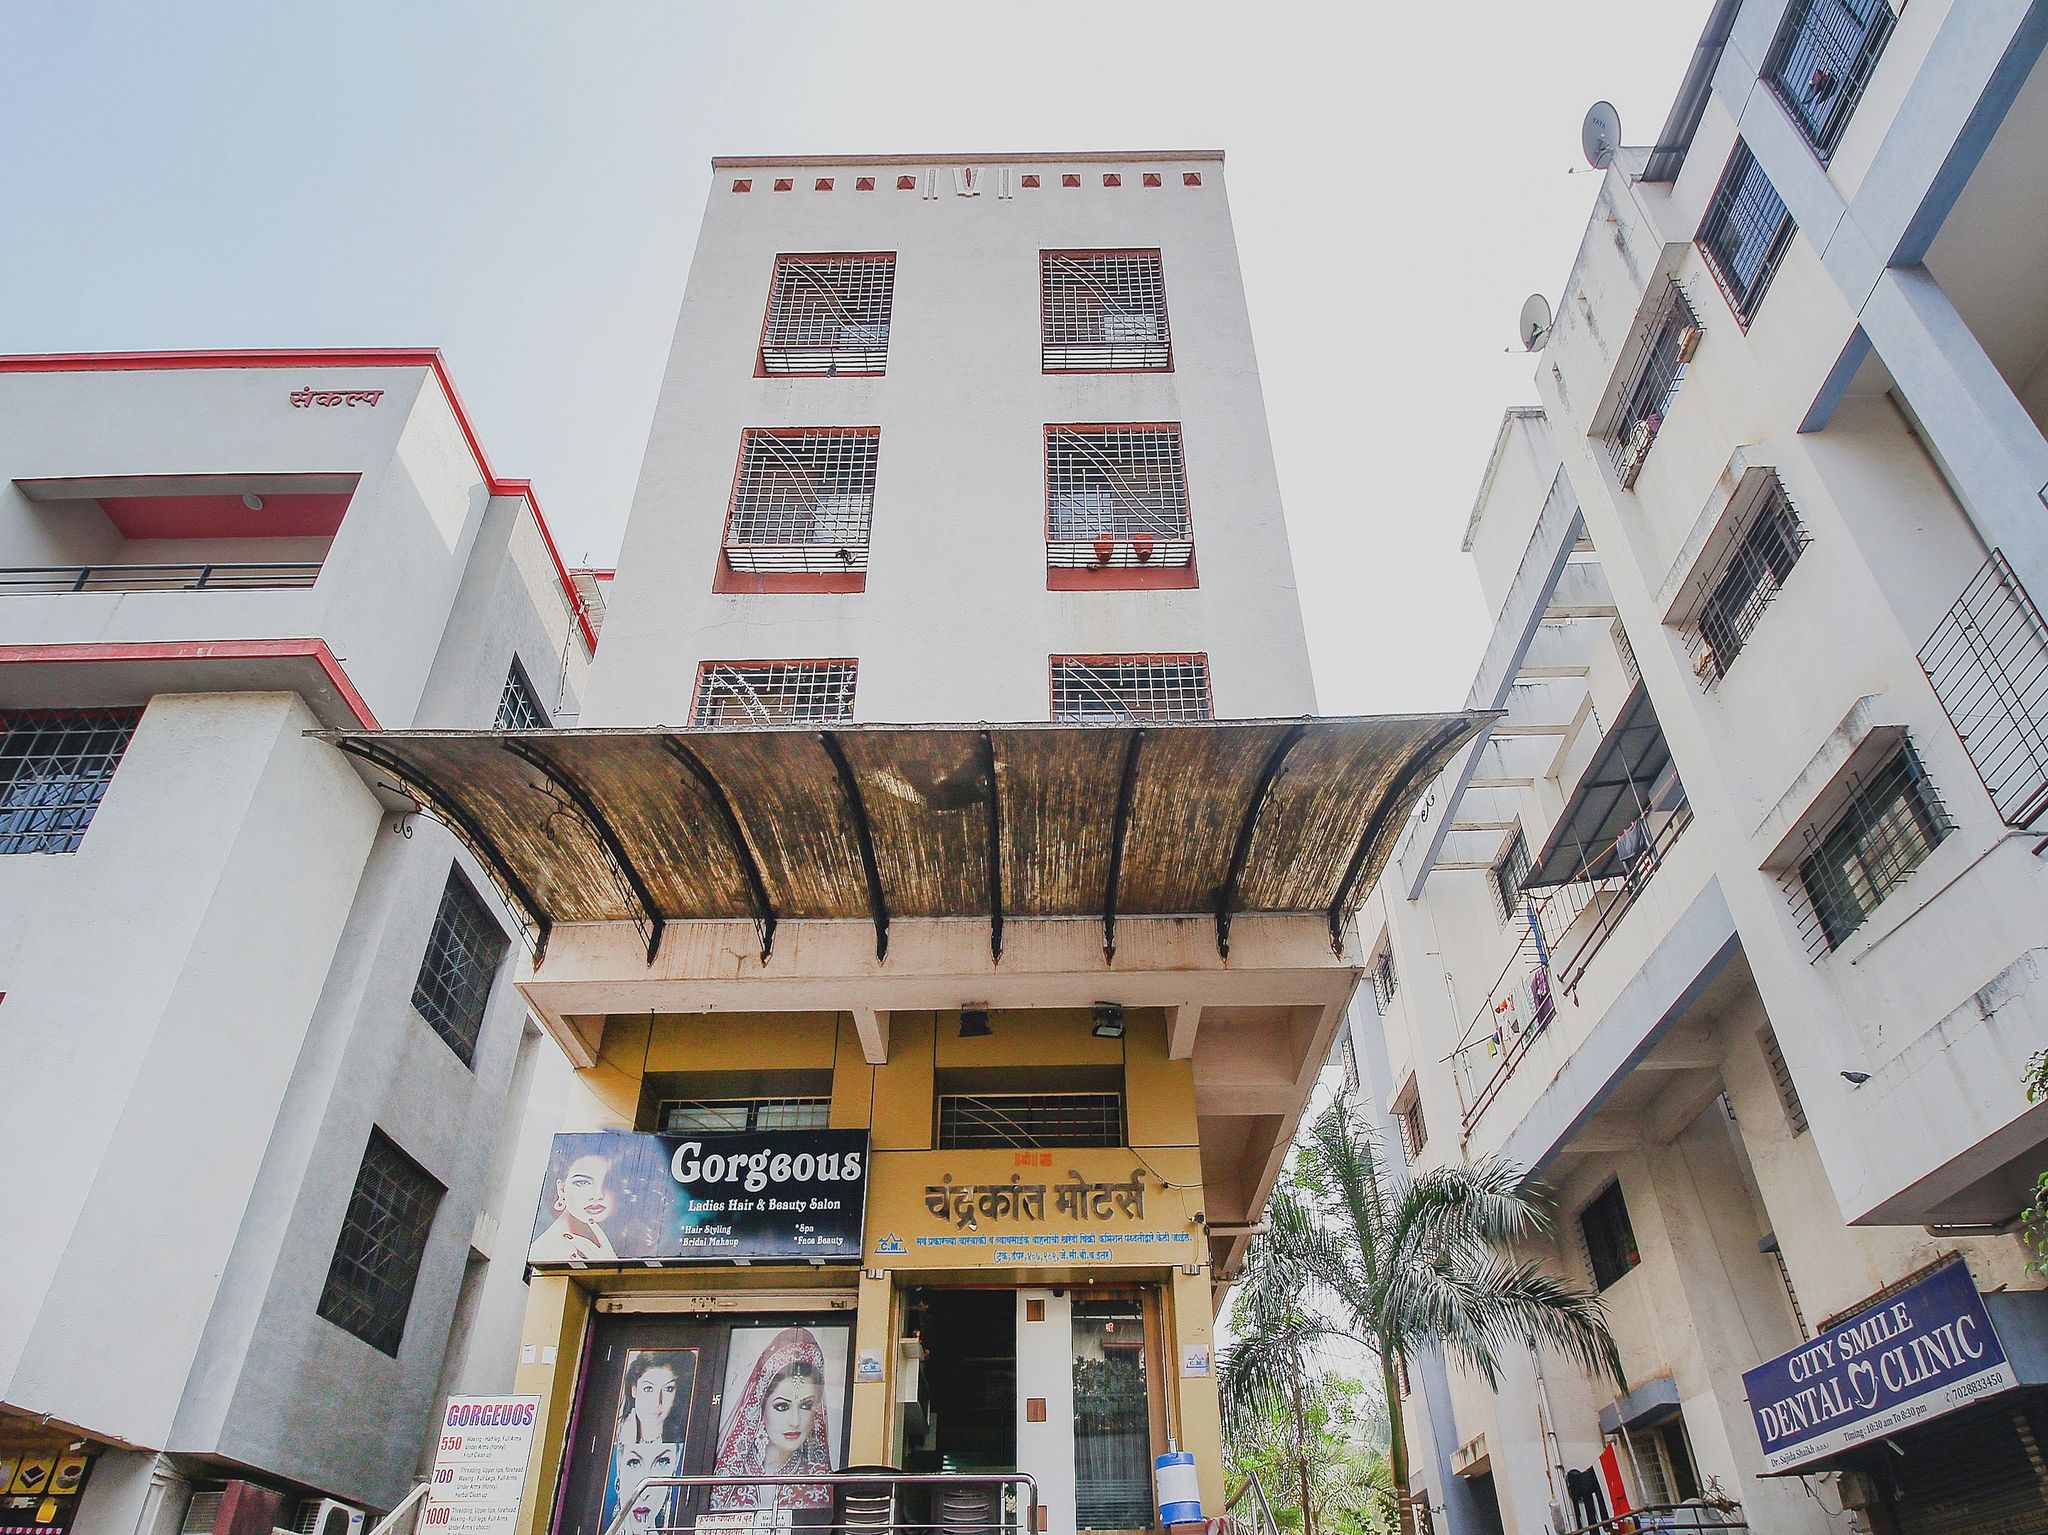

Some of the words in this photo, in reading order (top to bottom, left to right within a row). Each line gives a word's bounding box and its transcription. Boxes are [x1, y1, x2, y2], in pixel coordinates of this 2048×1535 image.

[290, 386, 384, 408] संकल्प
[671, 1141, 862, 1193] Gorgeous
[688, 1199, 726, 1212] Ladies
[727, 1198, 755, 1211] Hair
[756, 1199, 766, 1211] &
[768, 1198, 807, 1213] Beauty
[809, 1197, 841, 1211] Salon
[924, 1173, 1047, 1231] चंद्रकांत
[1054, 1168, 1146, 1221] मोटर्स
[704, 1224, 732, 1235] Styling
[817, 1235, 844, 1246] Beauty
[709, 1237, 739, 1247] Makeup
[1788, 1340, 1836, 1383] CITY
[1837, 1302, 1914, 1361] SMILE
[1759, 1376, 1854, 1442] DENTAL
[1880, 1314, 1984, 1393] CLINIC
[1952, 1372, 2003, 1400] 7028833450
[447, 1404, 535, 1427] GORGEUOS
[1883, 1417, 1894, 1428] am
[1915, 1403, 1928, 1417] pm
[441, 1436, 463, 1451] 550
[434, 1468, 454, 1484] 700
[425, 1507, 451, 1525] 1000
